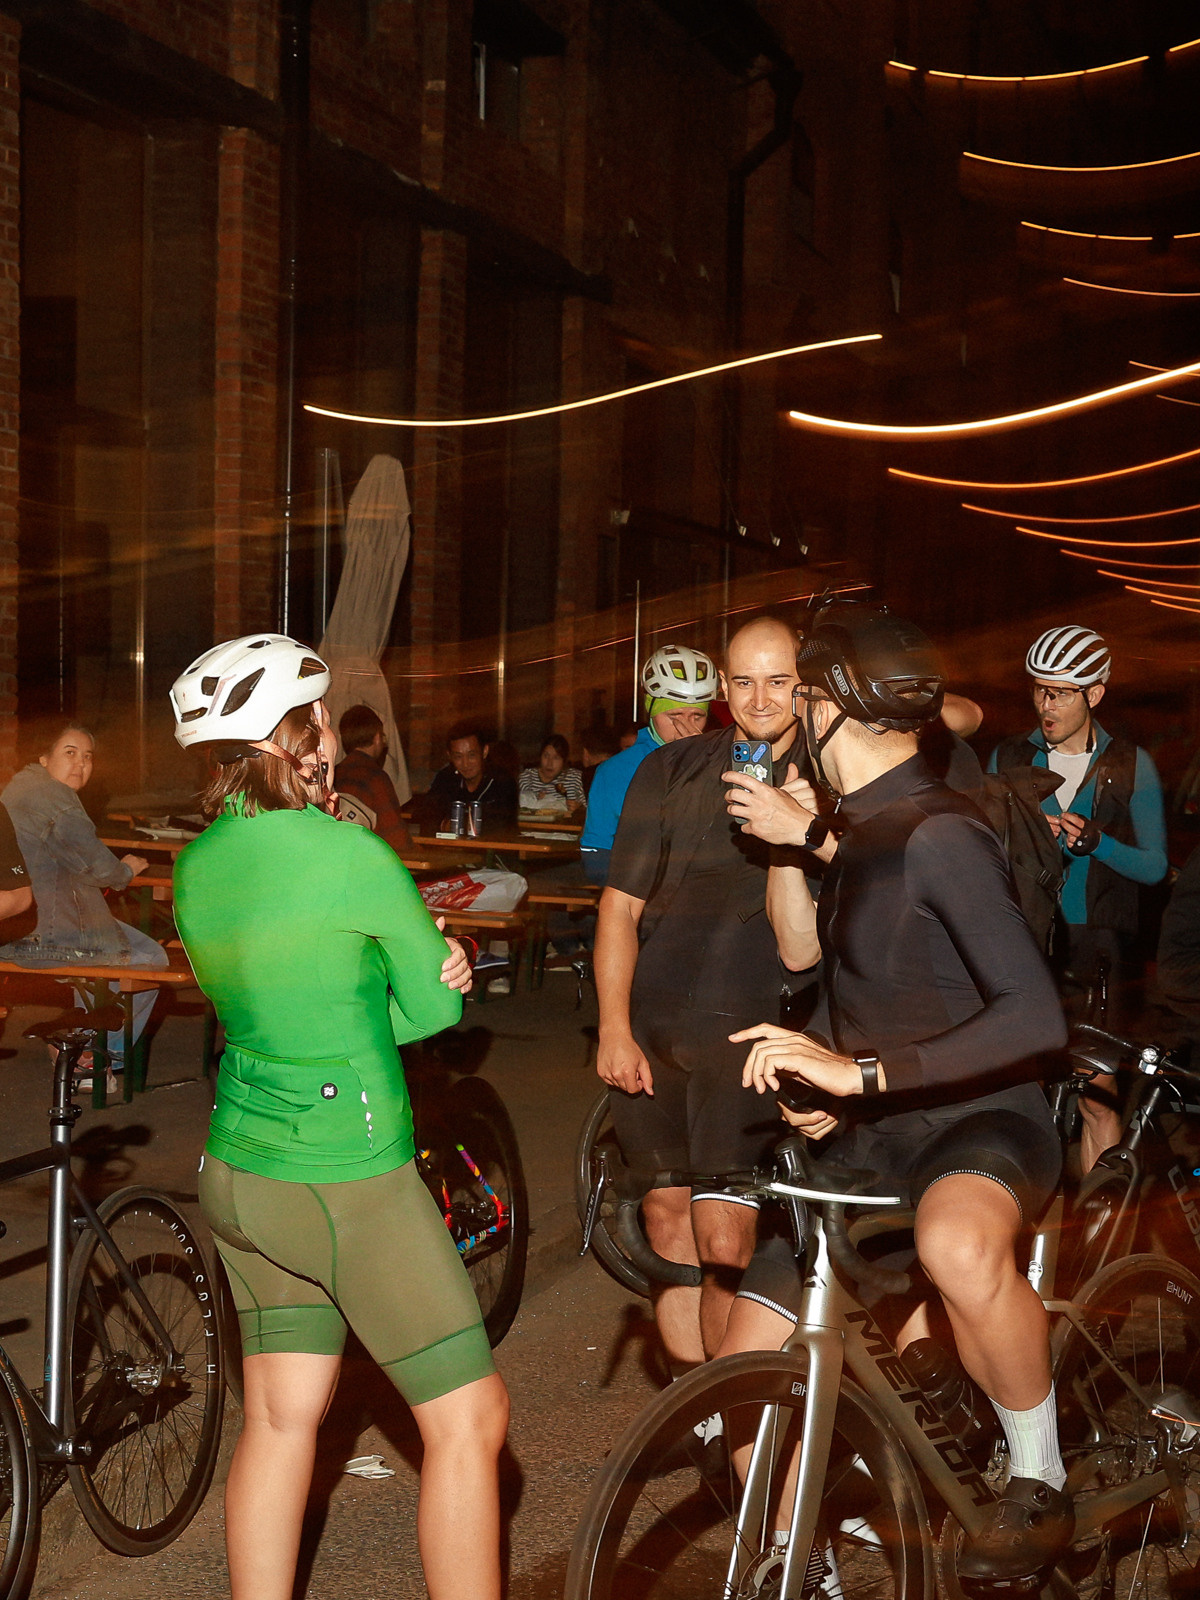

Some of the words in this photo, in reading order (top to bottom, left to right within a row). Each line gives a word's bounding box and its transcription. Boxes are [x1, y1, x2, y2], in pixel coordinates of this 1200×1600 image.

[833, 667, 848, 694] ABUS
[1172, 1282, 1193, 1305] HUNT
[207, 1364, 216, 1374] H
[843, 1309, 998, 1507] MERIDA
